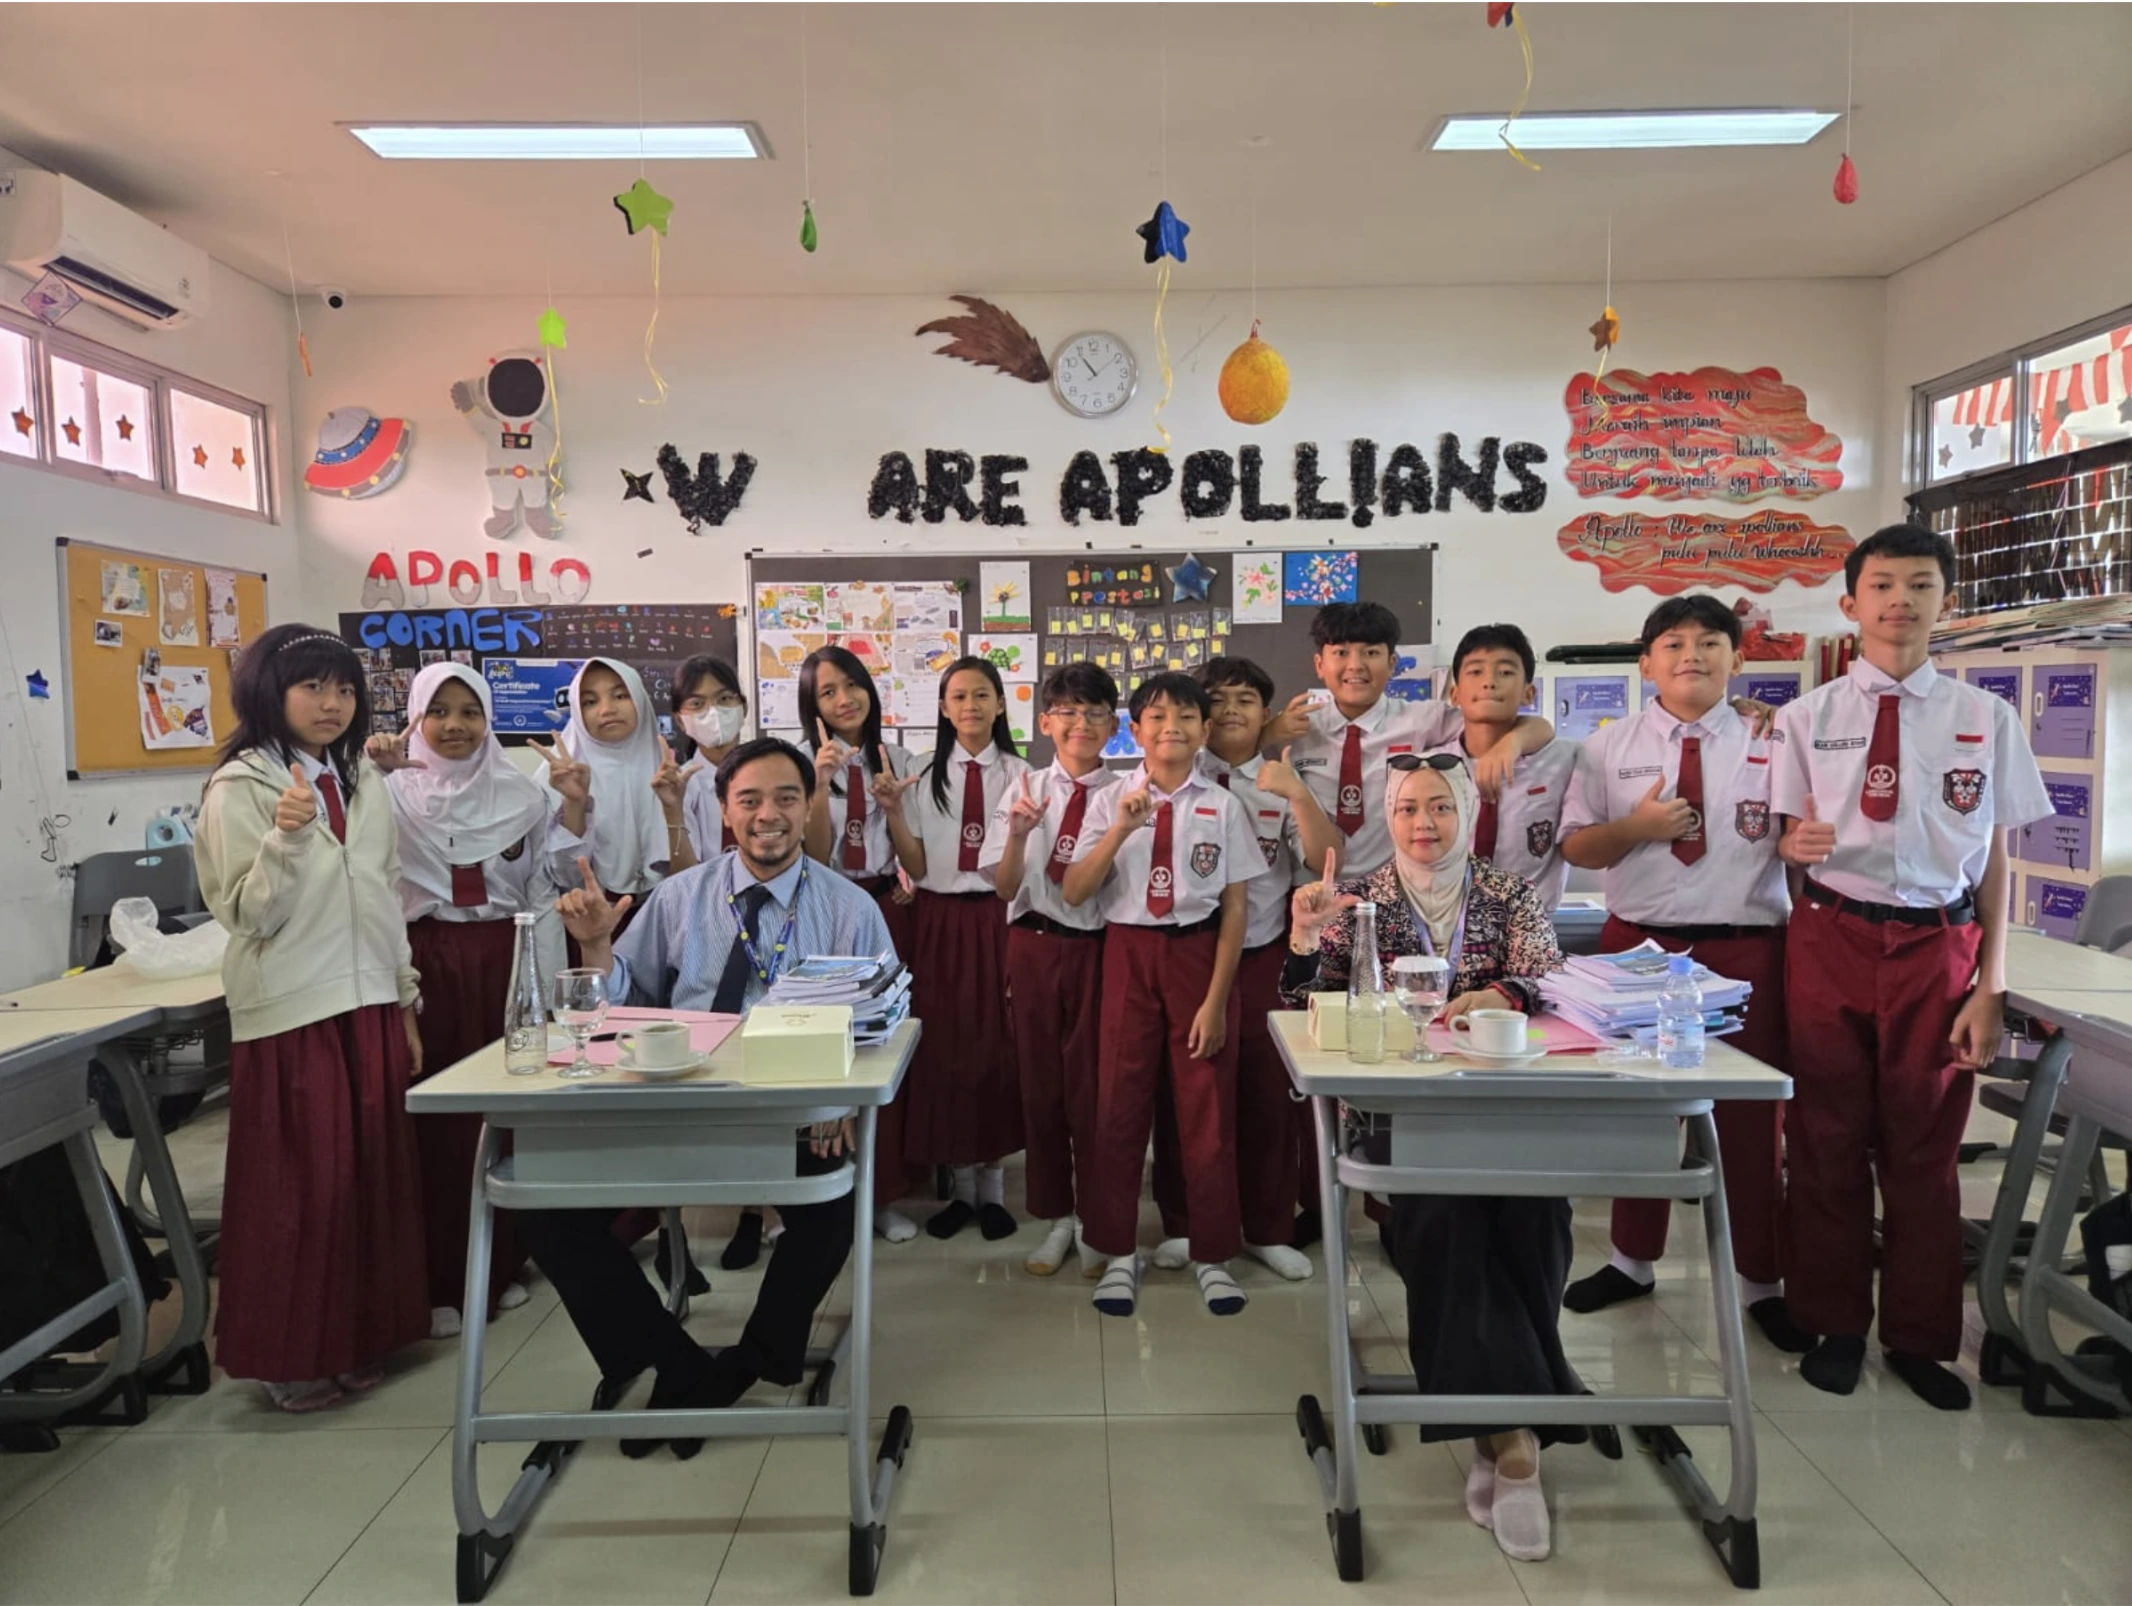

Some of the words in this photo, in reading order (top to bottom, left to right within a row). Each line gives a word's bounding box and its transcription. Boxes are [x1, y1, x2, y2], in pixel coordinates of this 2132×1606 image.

[1708, 388, 1751, 408] maju
[867, 448, 1029, 526] ARE
[1578, 515, 1642, 549] Apollo
[361, 550, 591, 610] APOLLO
[1066, 563, 1153, 587] Bintang
